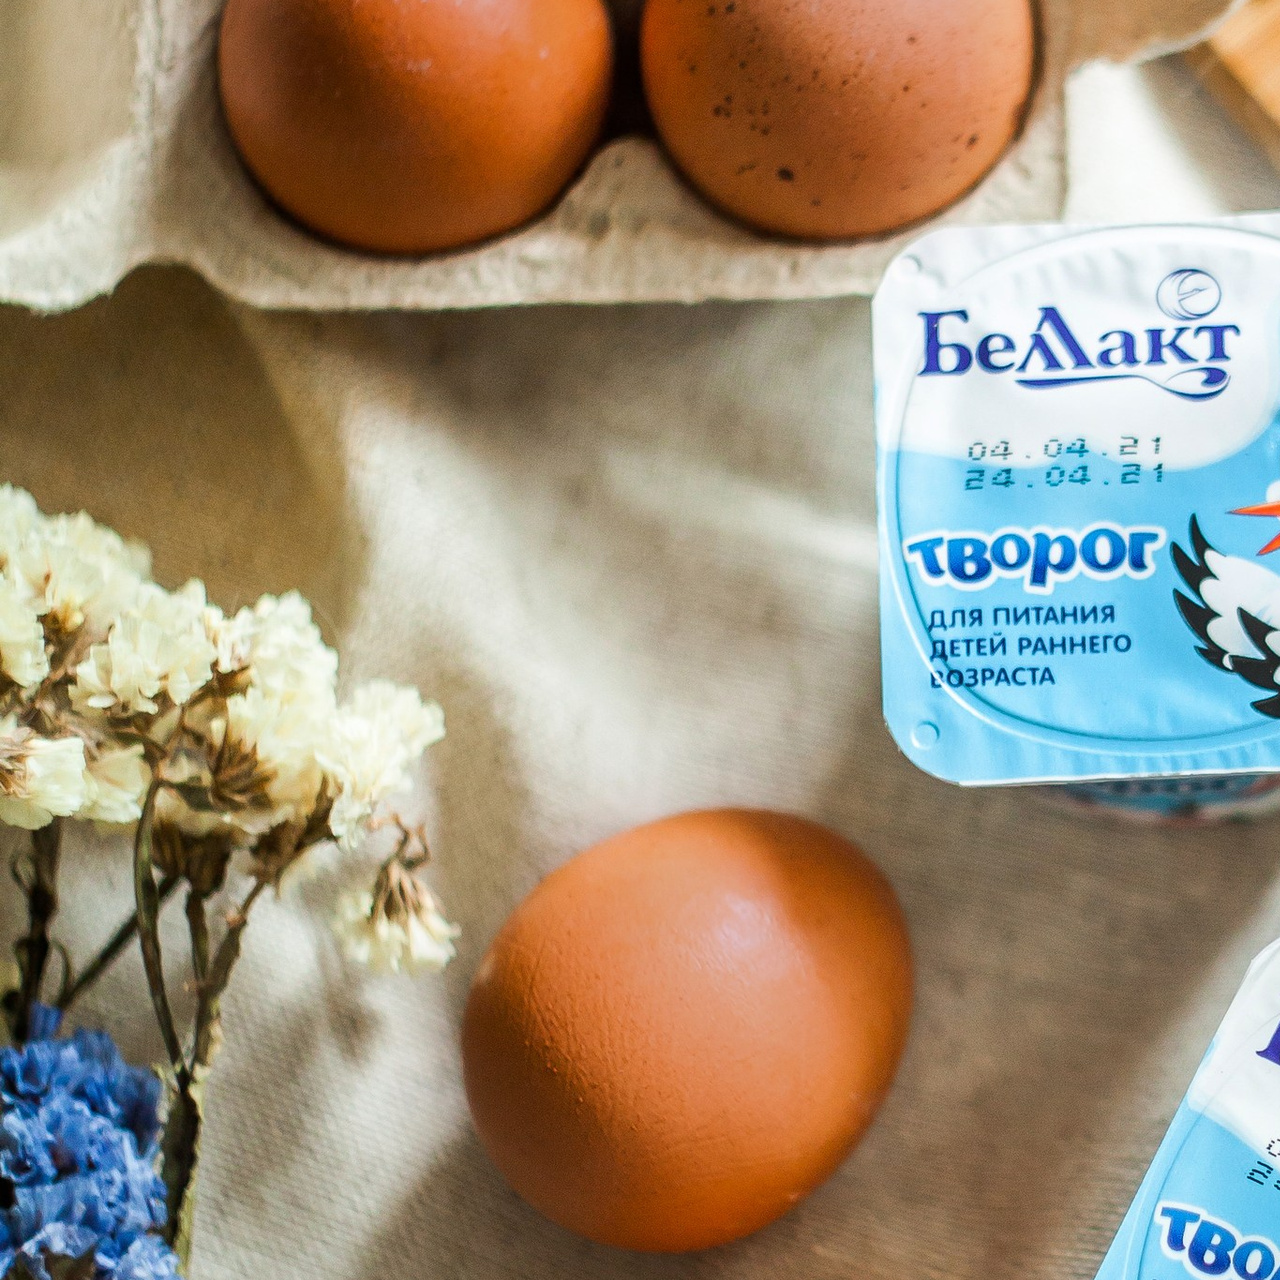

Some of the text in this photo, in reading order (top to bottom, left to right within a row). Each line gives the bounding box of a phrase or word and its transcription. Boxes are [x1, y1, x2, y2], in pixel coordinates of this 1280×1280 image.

[928, 604, 1117, 633] ДЛЯ ПИТАНИЯ
[928, 631, 1133, 663] ДЕТЕЙ РАННЕГО
[929, 666, 1057, 690] ВОЗРАСТА
